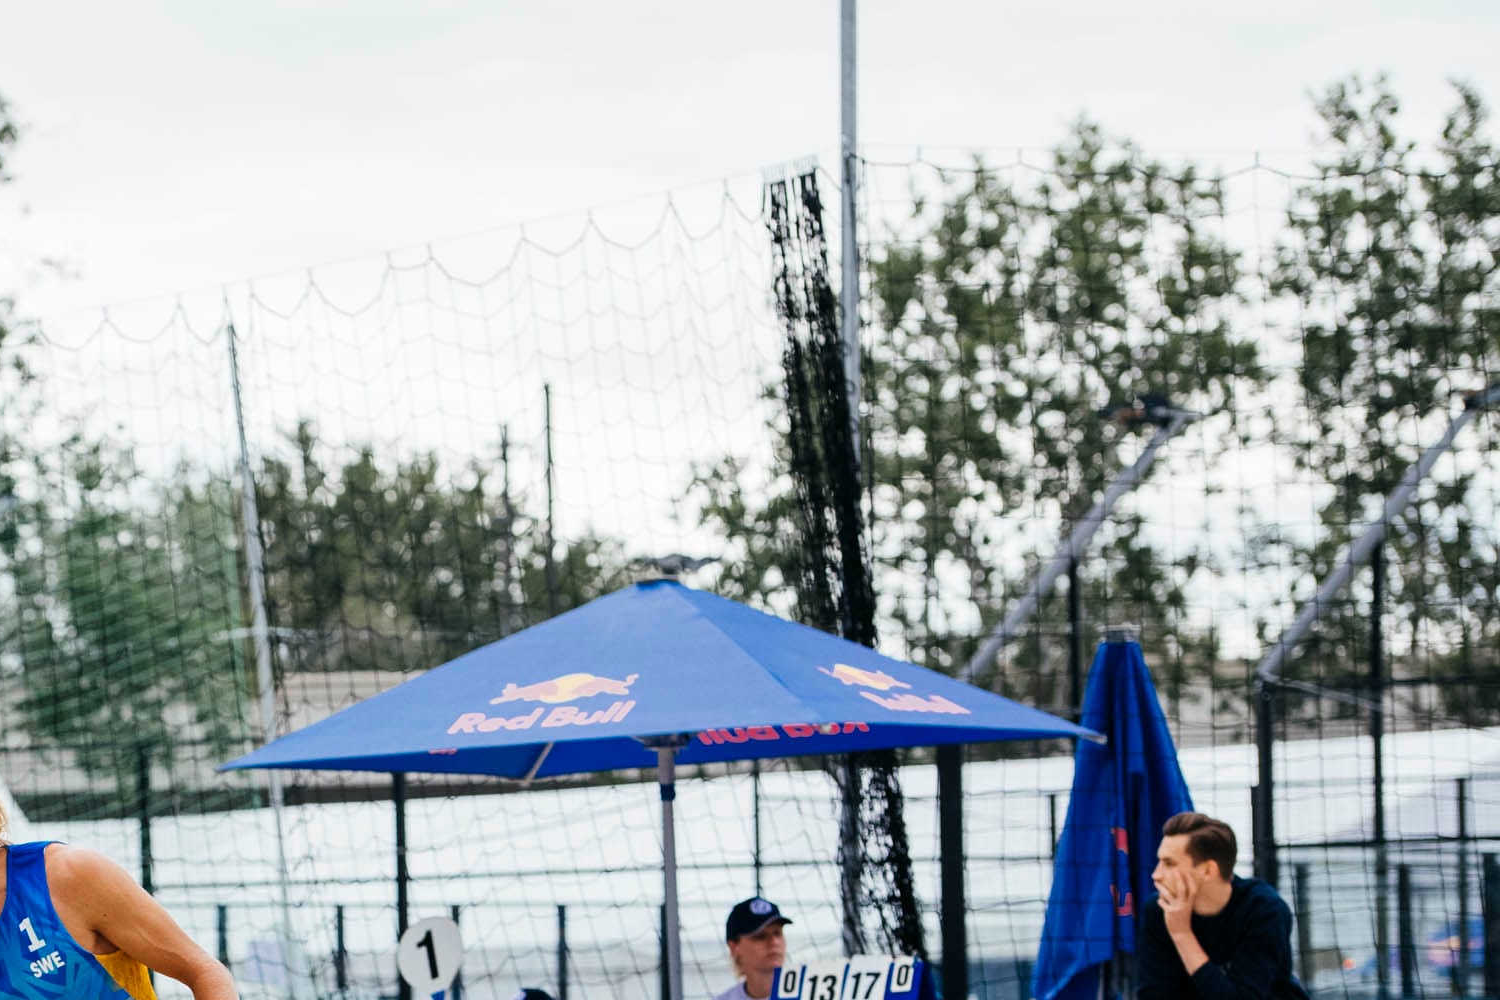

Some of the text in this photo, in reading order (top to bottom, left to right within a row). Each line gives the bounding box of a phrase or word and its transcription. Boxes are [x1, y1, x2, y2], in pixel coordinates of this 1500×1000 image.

[447, 700, 636, 734] Red Bull
[19, 917, 46, 952] 1
[29, 950, 66, 979] SWE
[416, 930, 439, 980] 1
[783, 971, 797, 993] 0
[852, 972, 881, 1000] 17
[896, 964, 911, 986] 0
